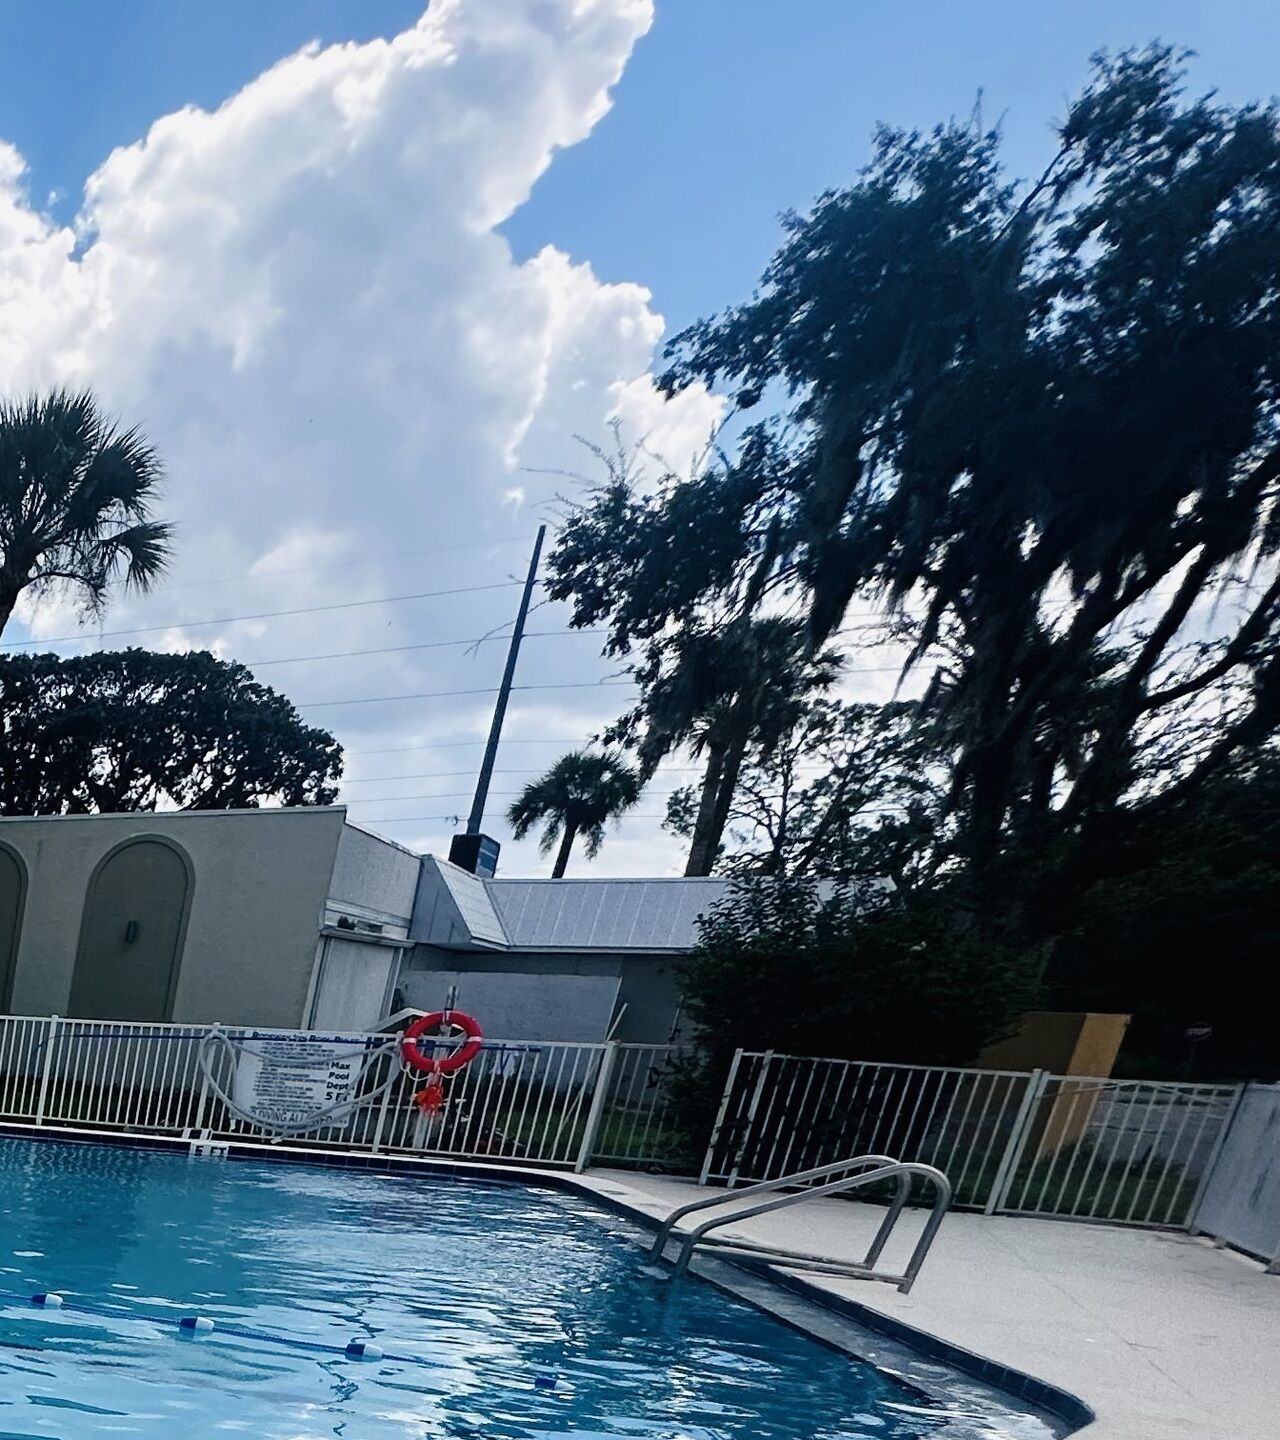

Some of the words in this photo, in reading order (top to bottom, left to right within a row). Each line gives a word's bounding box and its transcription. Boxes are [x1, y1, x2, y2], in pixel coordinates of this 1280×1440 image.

[331, 1062, 351, 1070] Max
[329, 1072, 350, 1080] Pool
[326, 1082, 355, 1091] Dept
[324, 1092, 334, 1101] 5
